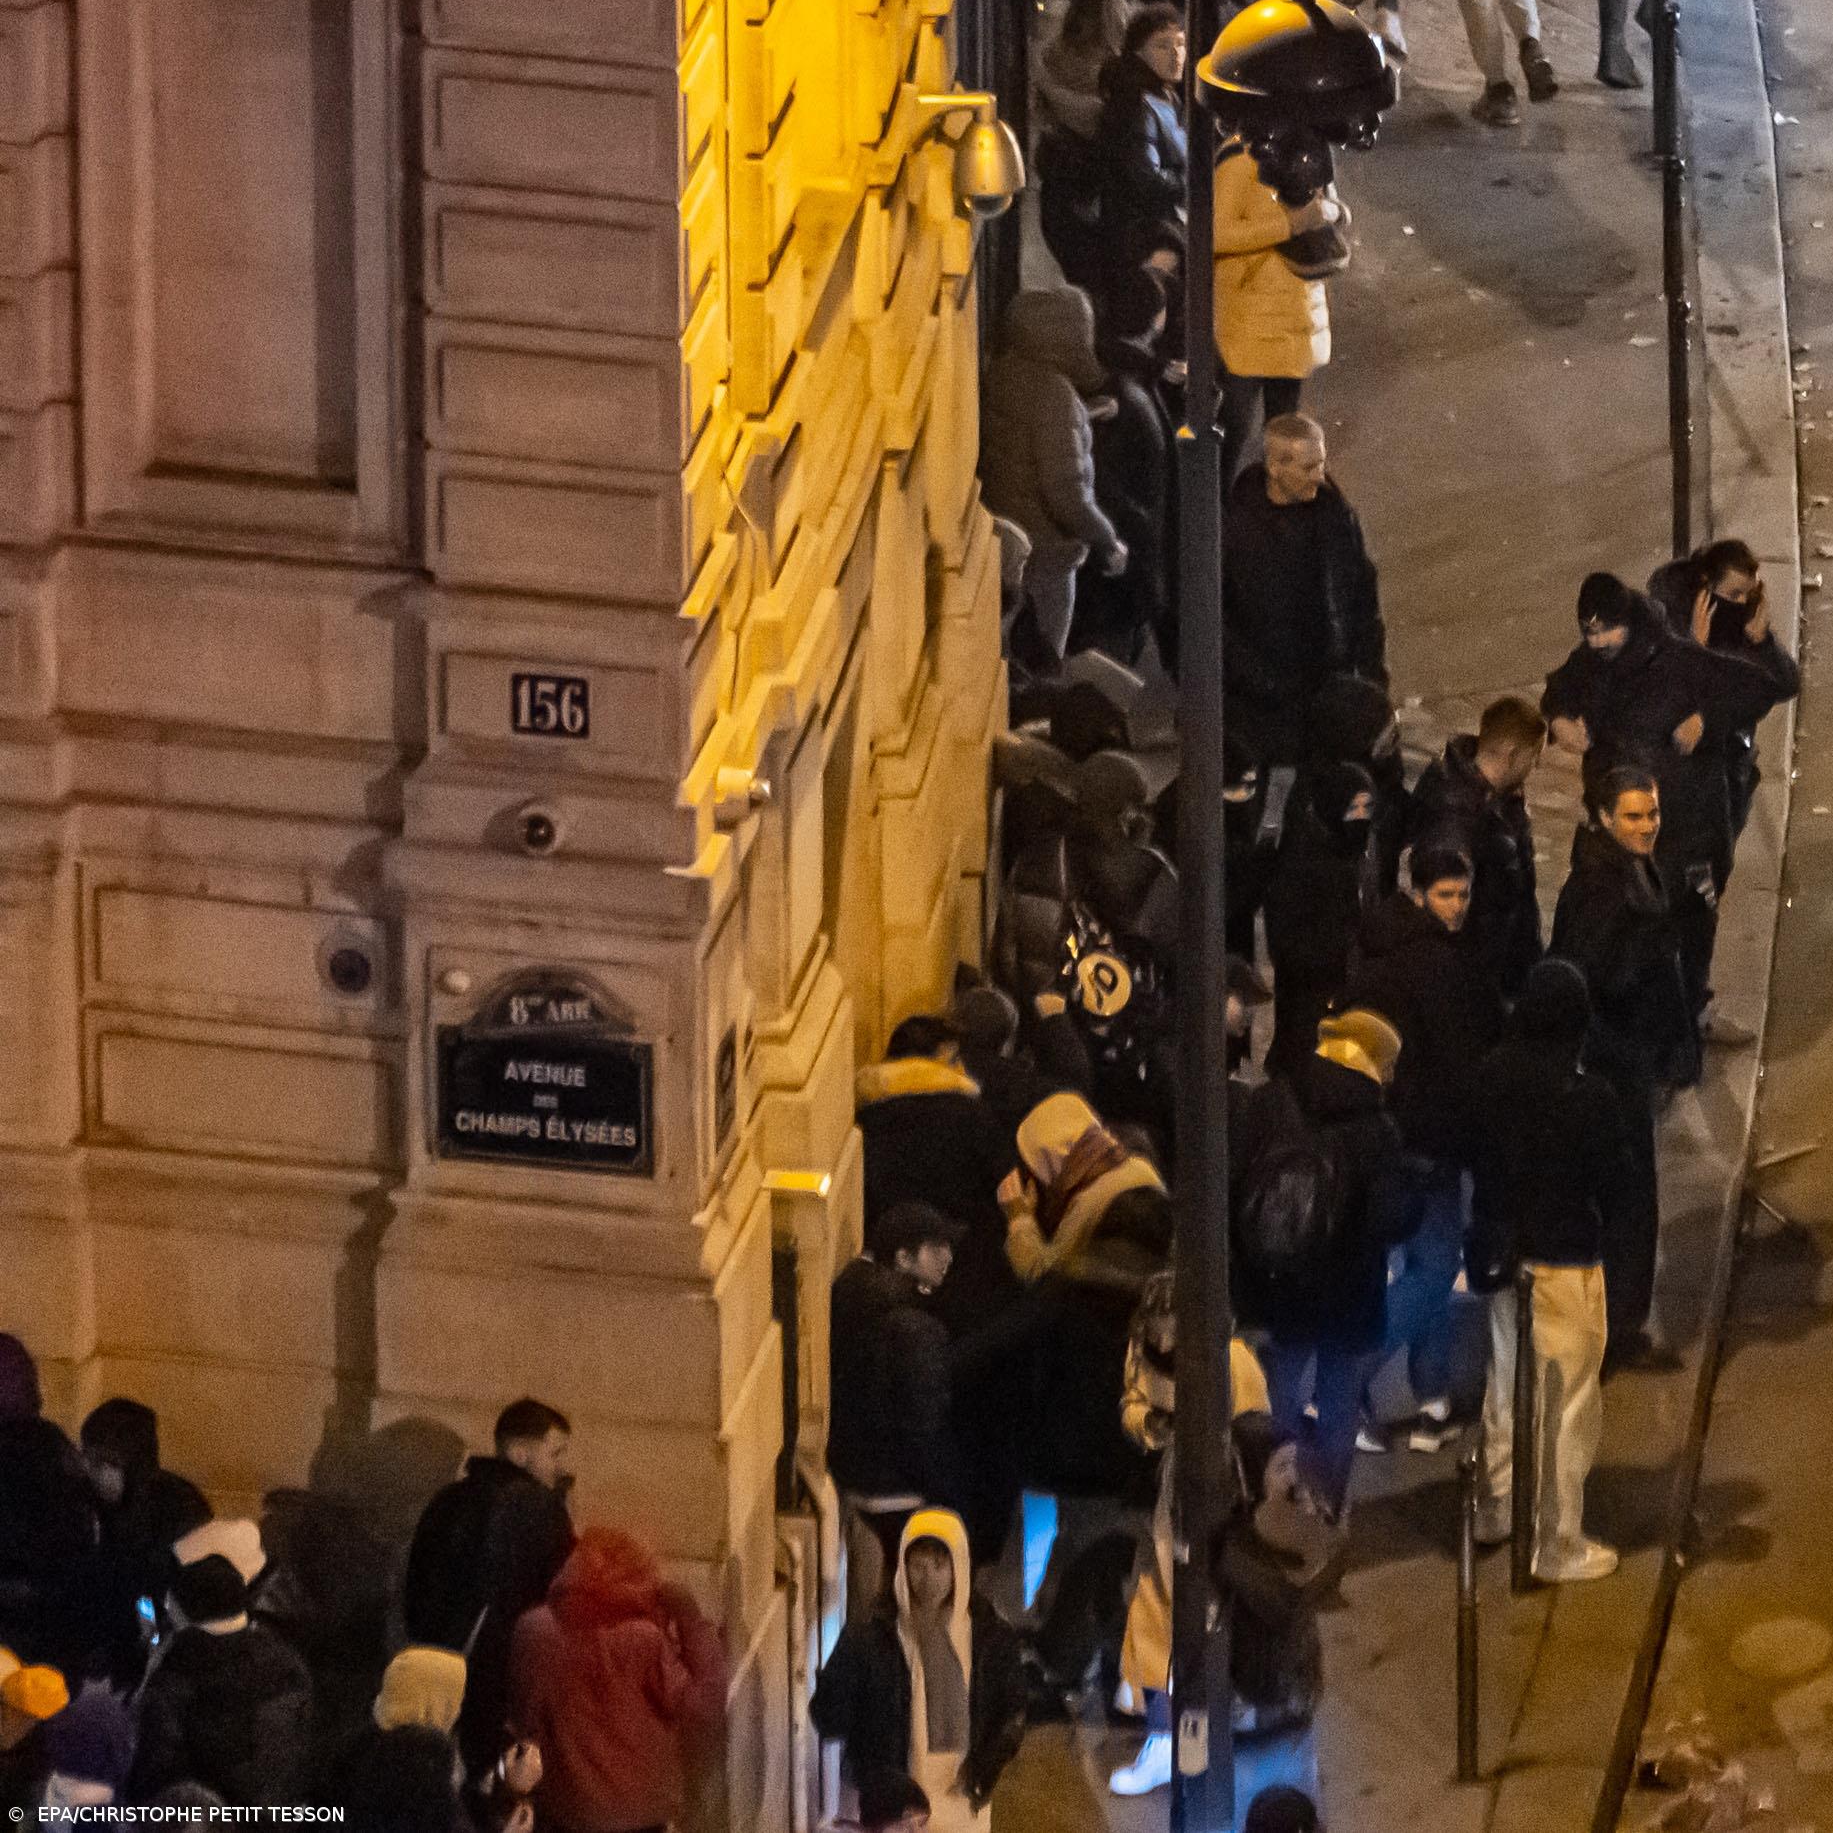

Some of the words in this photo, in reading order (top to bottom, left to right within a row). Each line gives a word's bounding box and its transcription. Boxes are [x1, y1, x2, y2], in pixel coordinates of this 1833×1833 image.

[518, 676, 585, 734] 156
[504, 1061, 587, 1088] AVENUE
[455, 1109, 541, 1139] CHAMPS
